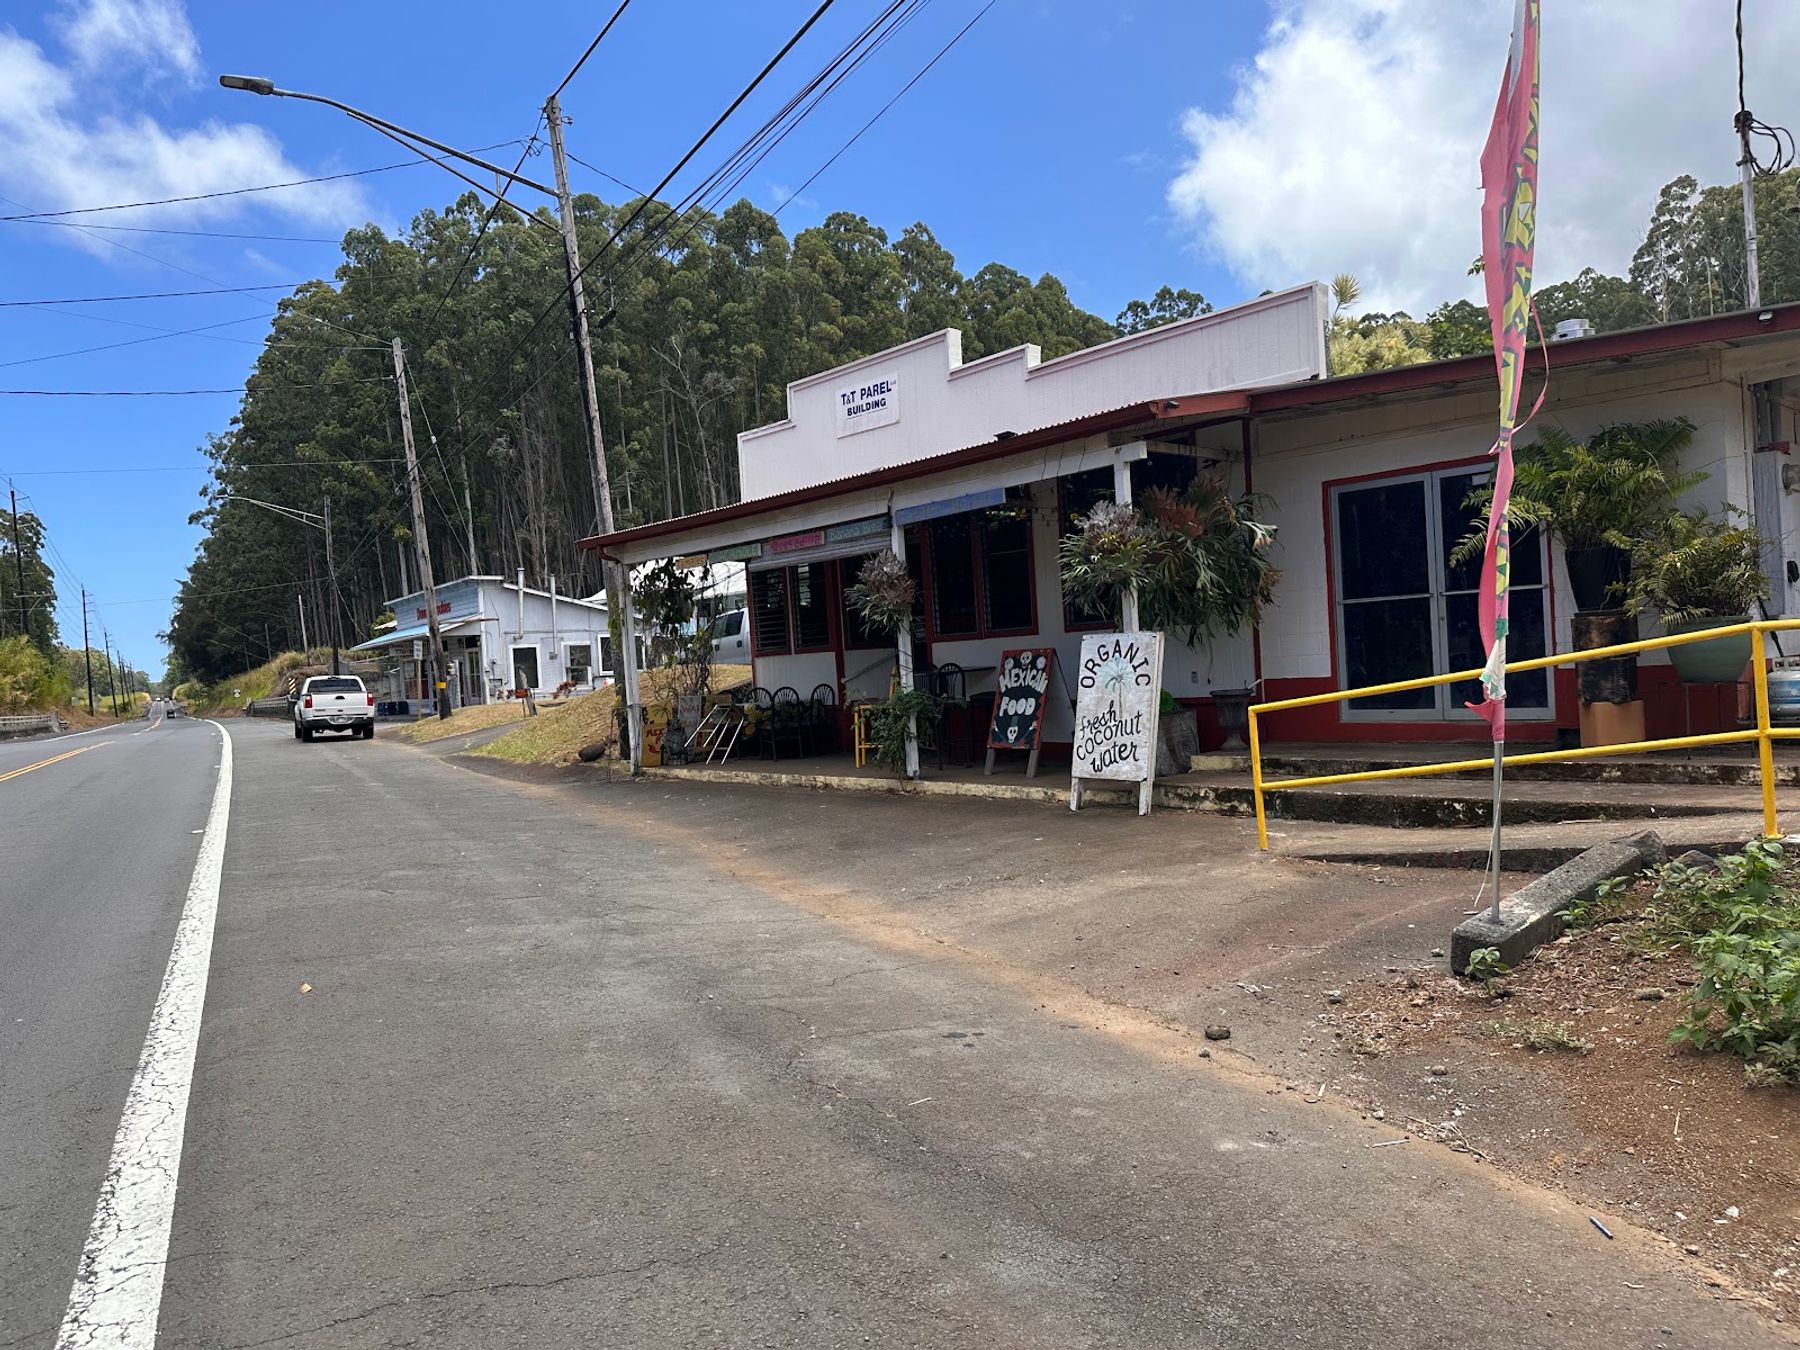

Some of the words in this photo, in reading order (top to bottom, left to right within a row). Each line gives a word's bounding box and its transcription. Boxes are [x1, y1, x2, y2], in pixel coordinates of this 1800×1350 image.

[841, 391, 856, 405] T&T
[860, 380, 892, 401] PAREL
[847, 397, 887, 417] BUILDING
[1080, 639, 1151, 689] ORGANIC
[998, 665, 1049, 694] MEXICAN
[999, 696, 1036, 717] FOOD
[1080, 700, 1118, 740] fresh
[1076, 710, 1143, 761] coconut
[1090, 741, 1140, 773] water
